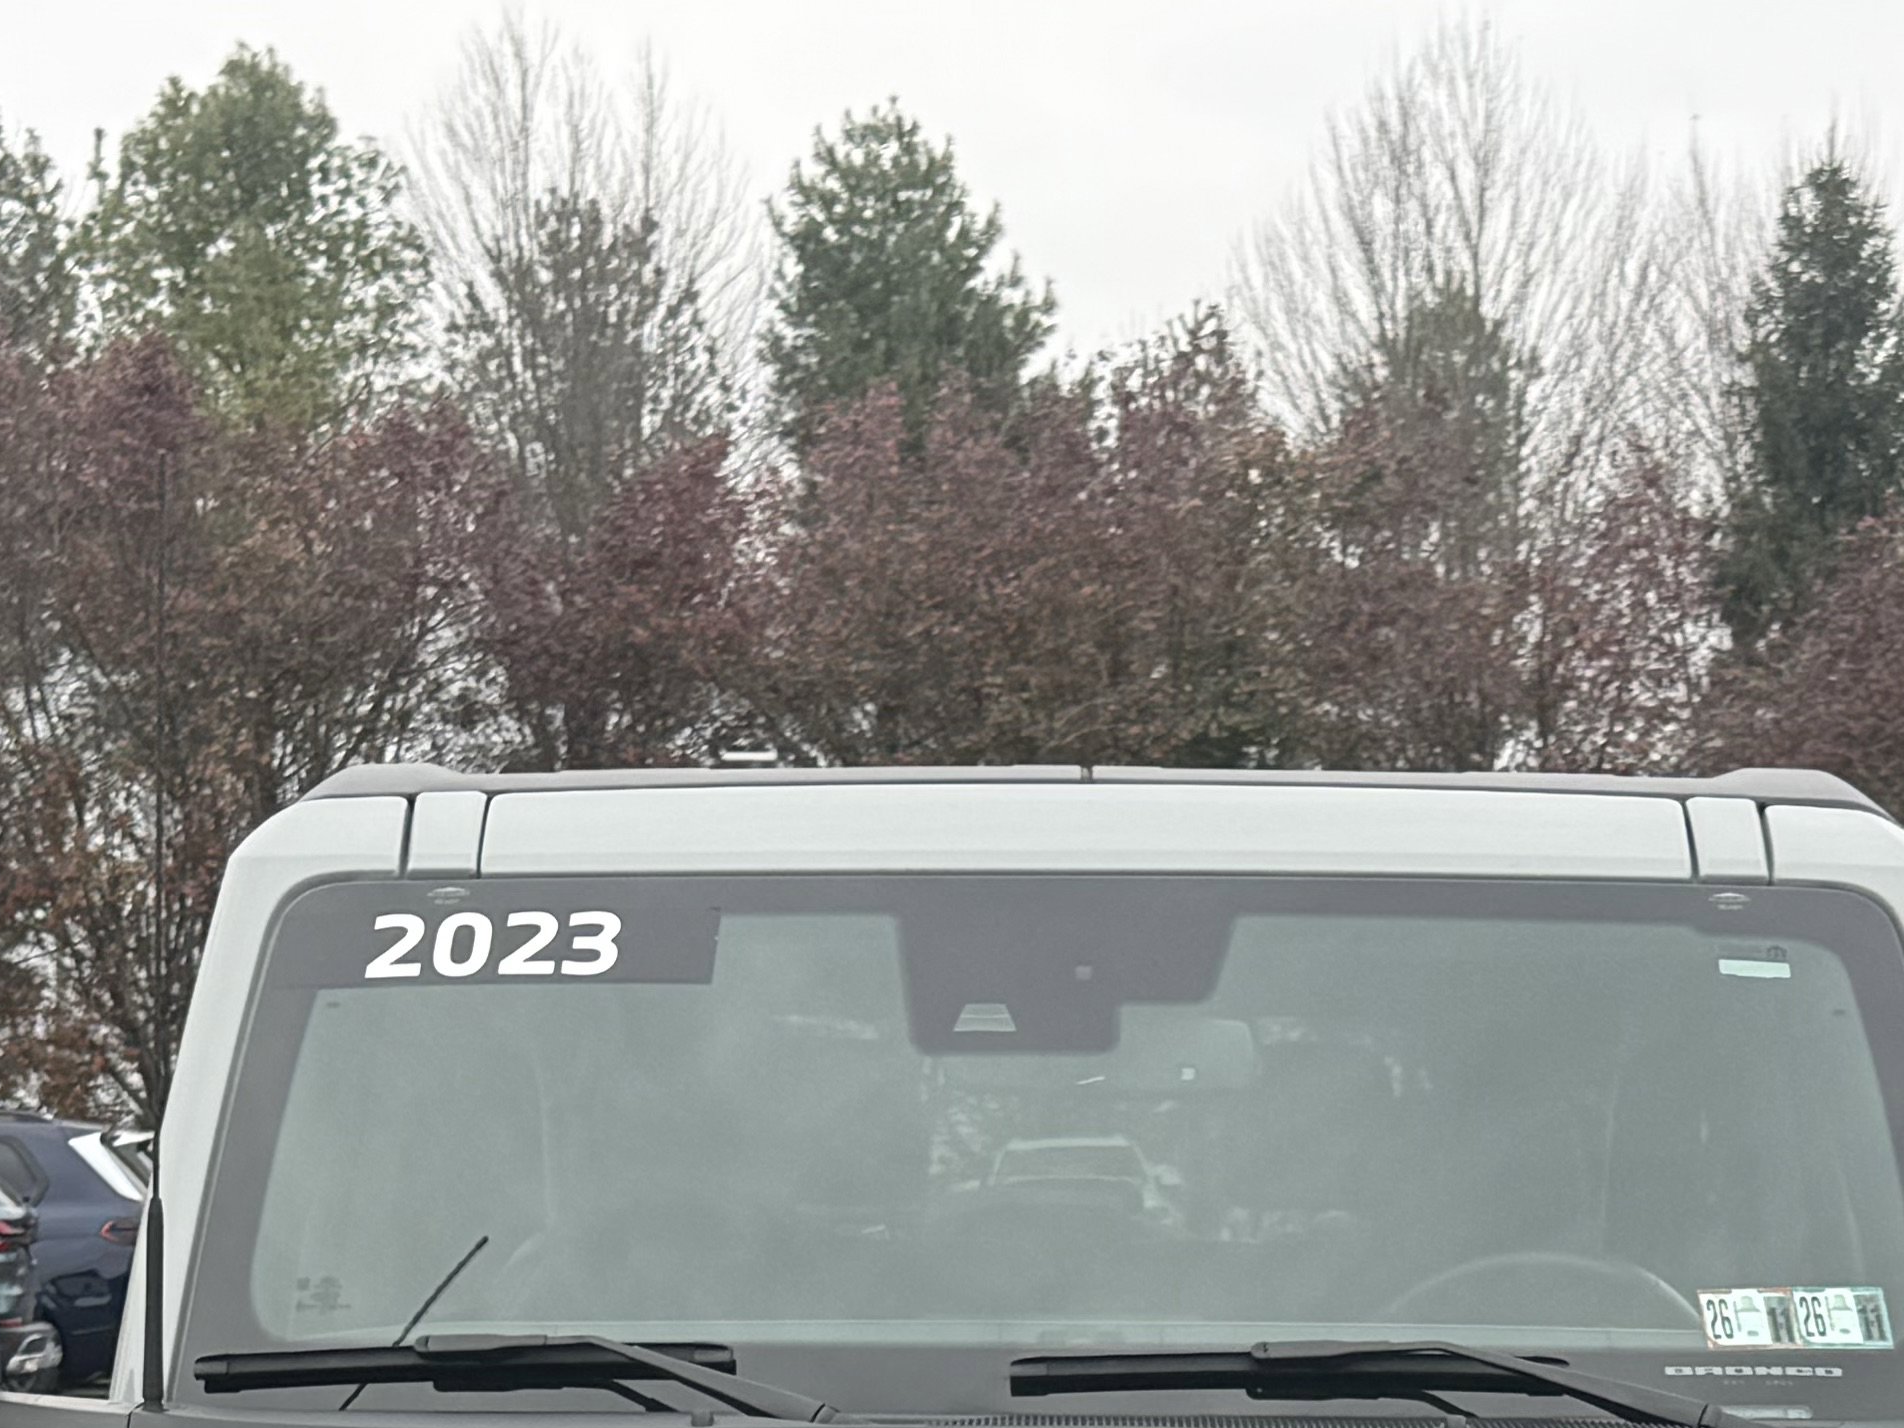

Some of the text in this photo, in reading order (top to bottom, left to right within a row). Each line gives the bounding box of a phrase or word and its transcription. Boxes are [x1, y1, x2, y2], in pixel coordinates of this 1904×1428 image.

[364, 911, 622, 979] 2023
[1706, 1298, 1734, 1339] 26
[1799, 1296, 1828, 1338] 26
[1664, 1366, 1843, 1377] BRONCO
